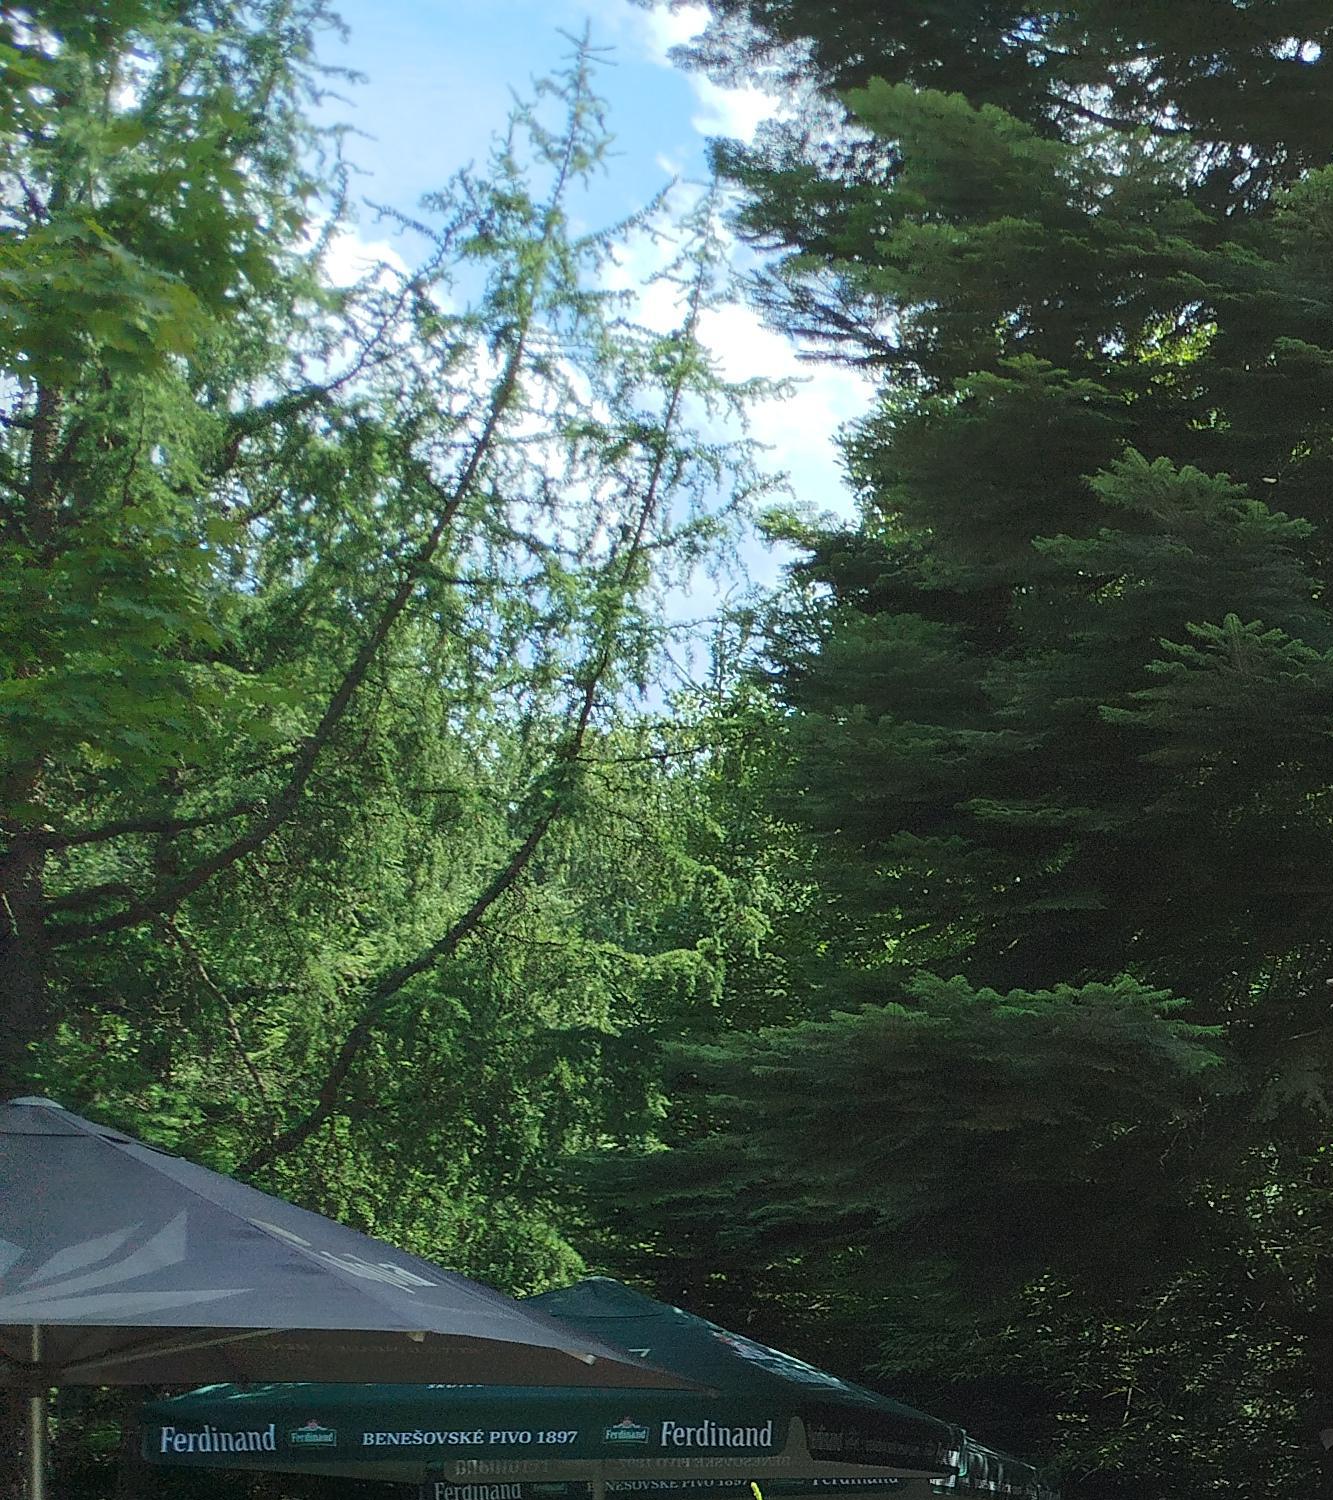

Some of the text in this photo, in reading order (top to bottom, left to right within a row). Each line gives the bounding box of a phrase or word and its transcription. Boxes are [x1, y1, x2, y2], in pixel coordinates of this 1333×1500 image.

[160, 1423, 276, 1452] Ferdinand
[362, 1429, 485, 1446] BENEŠOVSKÉ
[490, 1430, 532, 1444] PIVO
[537, 1430, 578, 1444] 1897
[660, 1419, 772, 1448] Ferdinand
